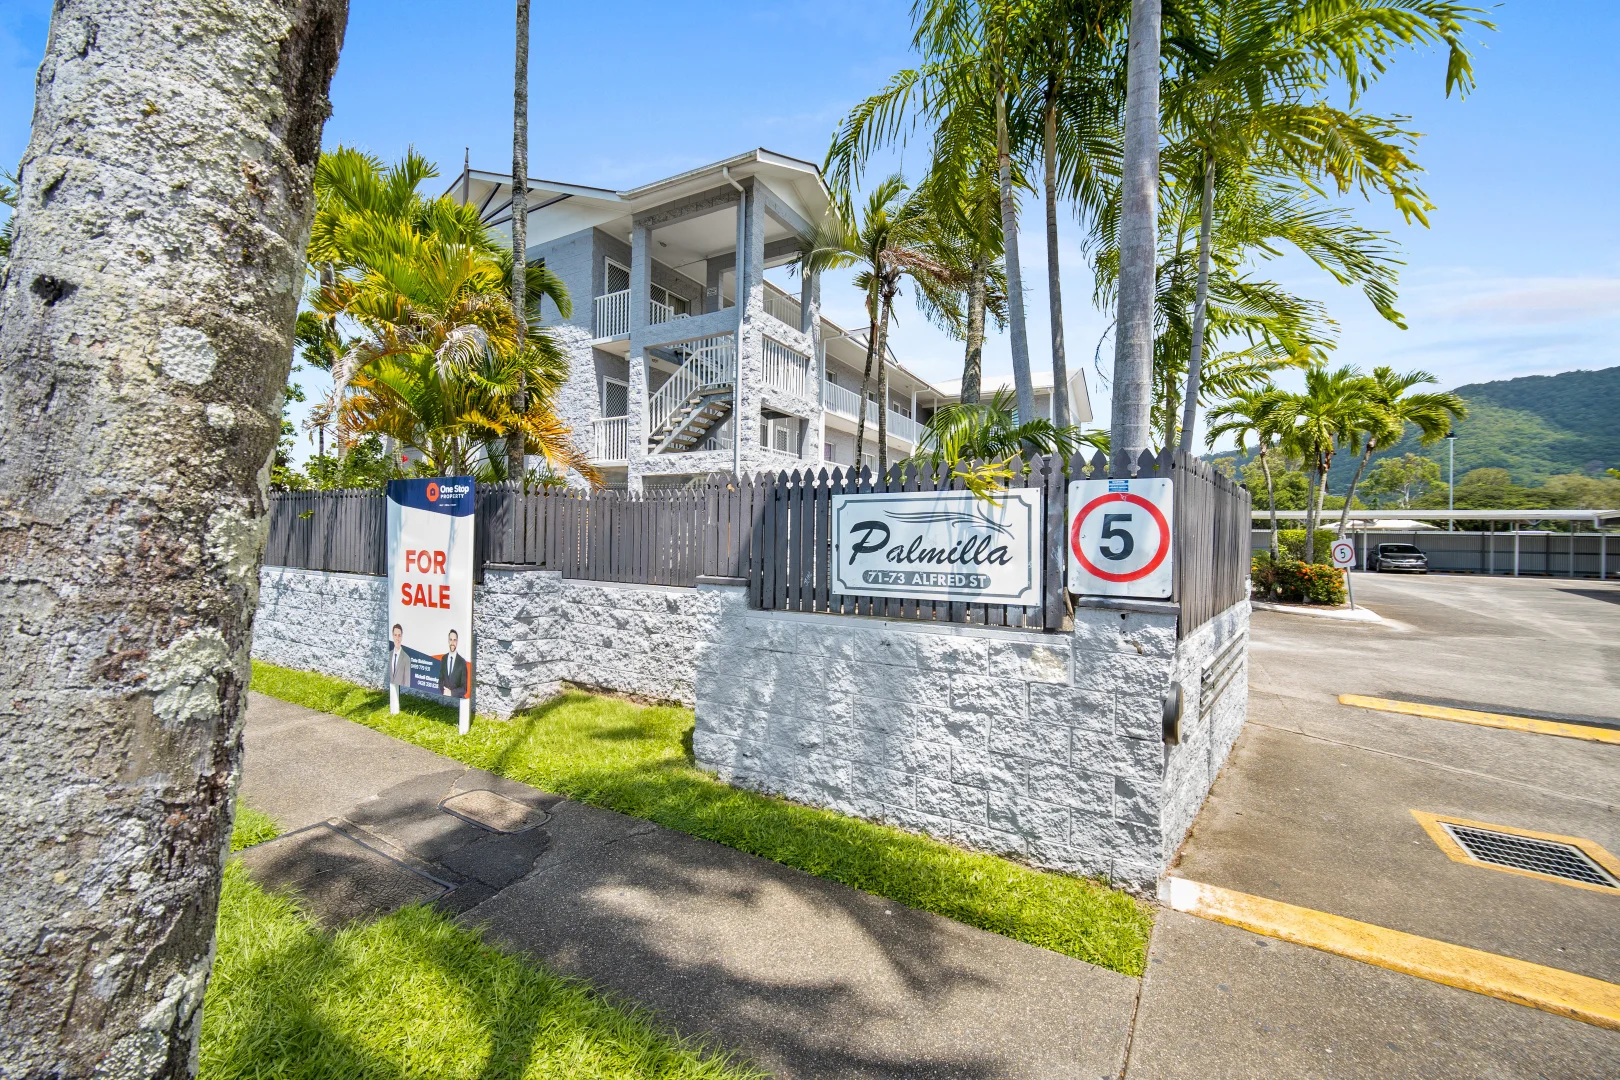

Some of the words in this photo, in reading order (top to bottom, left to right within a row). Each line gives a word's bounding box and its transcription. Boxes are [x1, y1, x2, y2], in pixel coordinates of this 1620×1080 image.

[440, 485, 454, 493] One
[454, 484, 470, 494] Stop
[848, 520, 1013, 566] Palmilla
[1099, 513, 1134, 560] 5
[405, 549, 447, 574] FOR
[1340, 547, 1346, 559] 5
[868, 571, 906, 584] 71-73
[911, 573, 966, 587] ALFRED
[969, 575, 987, 588] ST
[401, 582, 451, 609] SALE
